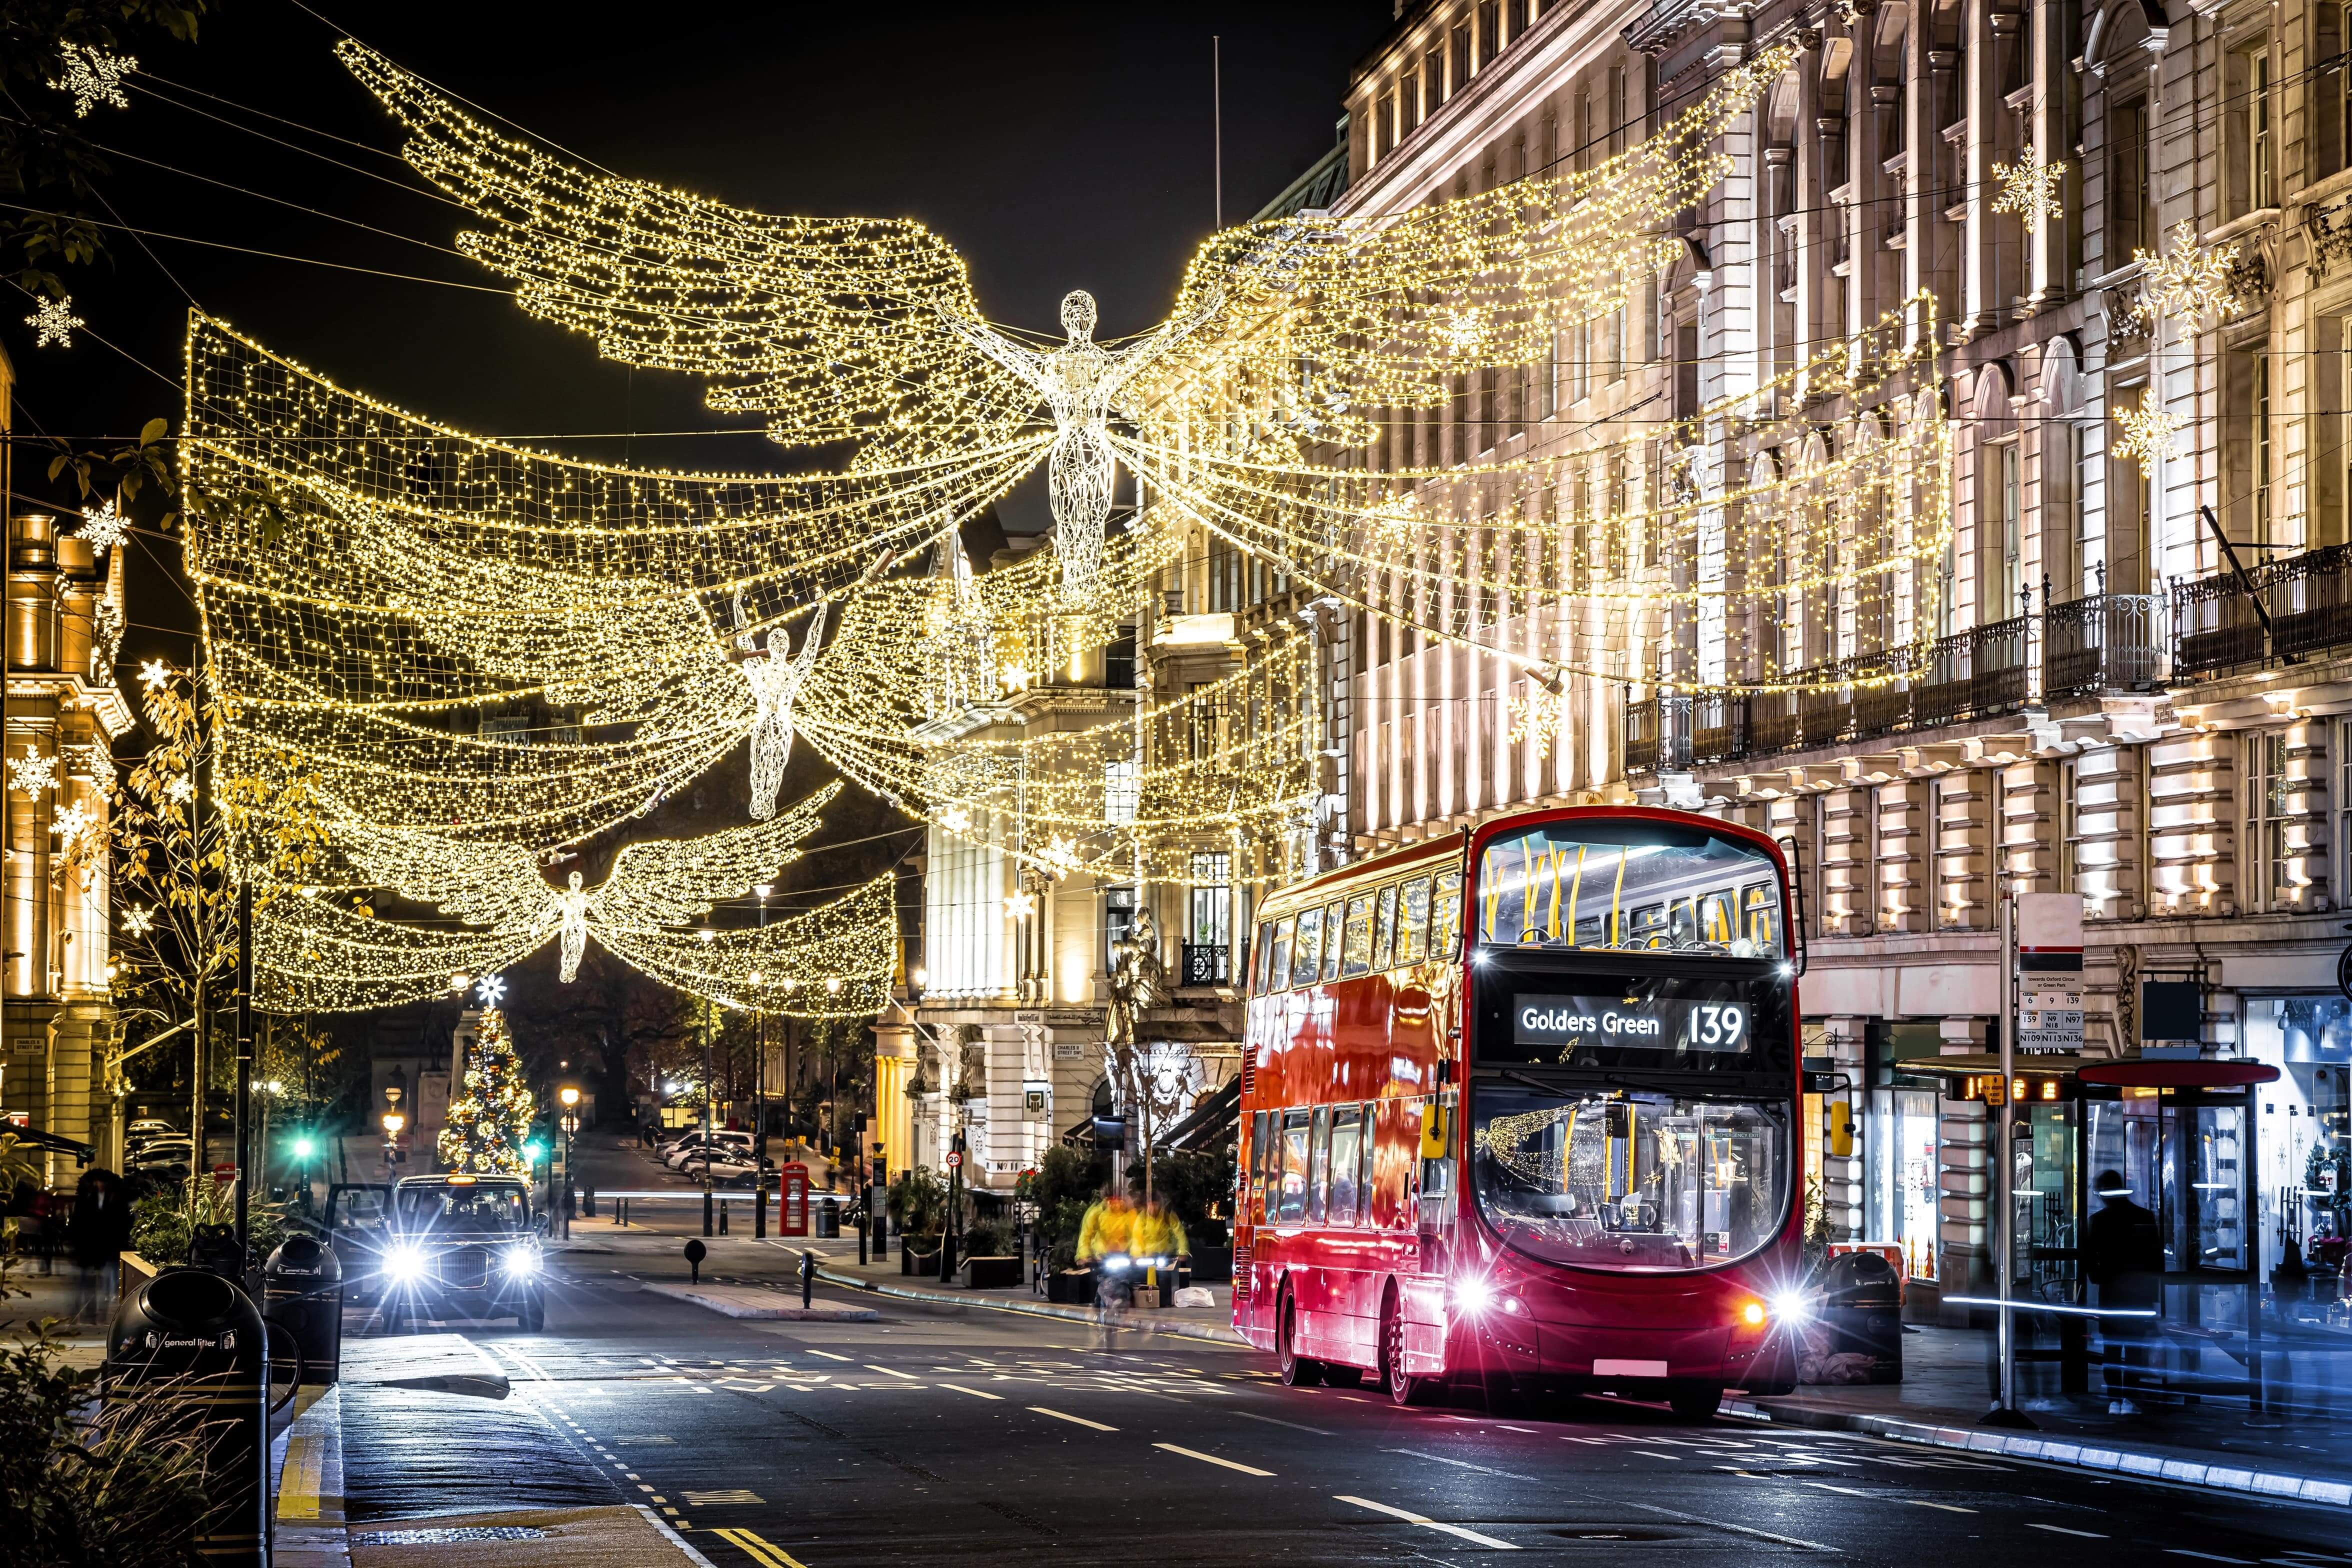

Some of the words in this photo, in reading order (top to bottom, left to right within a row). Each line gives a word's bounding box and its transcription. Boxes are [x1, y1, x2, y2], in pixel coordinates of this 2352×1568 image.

[1522, 1008, 1596, 1032] Golders
[1602, 1012, 1659, 1034] Green
[1691, 1006, 1742, 1044] 139
[165, 1338, 196, 1348] general
[198, 1338, 216, 1346] litter
[964, 1360, 1084, 1368] ST
[624, 1376, 832, 1386] AVE
[989, 1374, 1226, 1386] DILY
[568, 1383, 928, 1396] SHAFT
[1046, 1384, 1236, 1395] PIC
[1558, 1434, 1936, 1454] STOP
[1695, 1450, 2017, 1472] BUS
